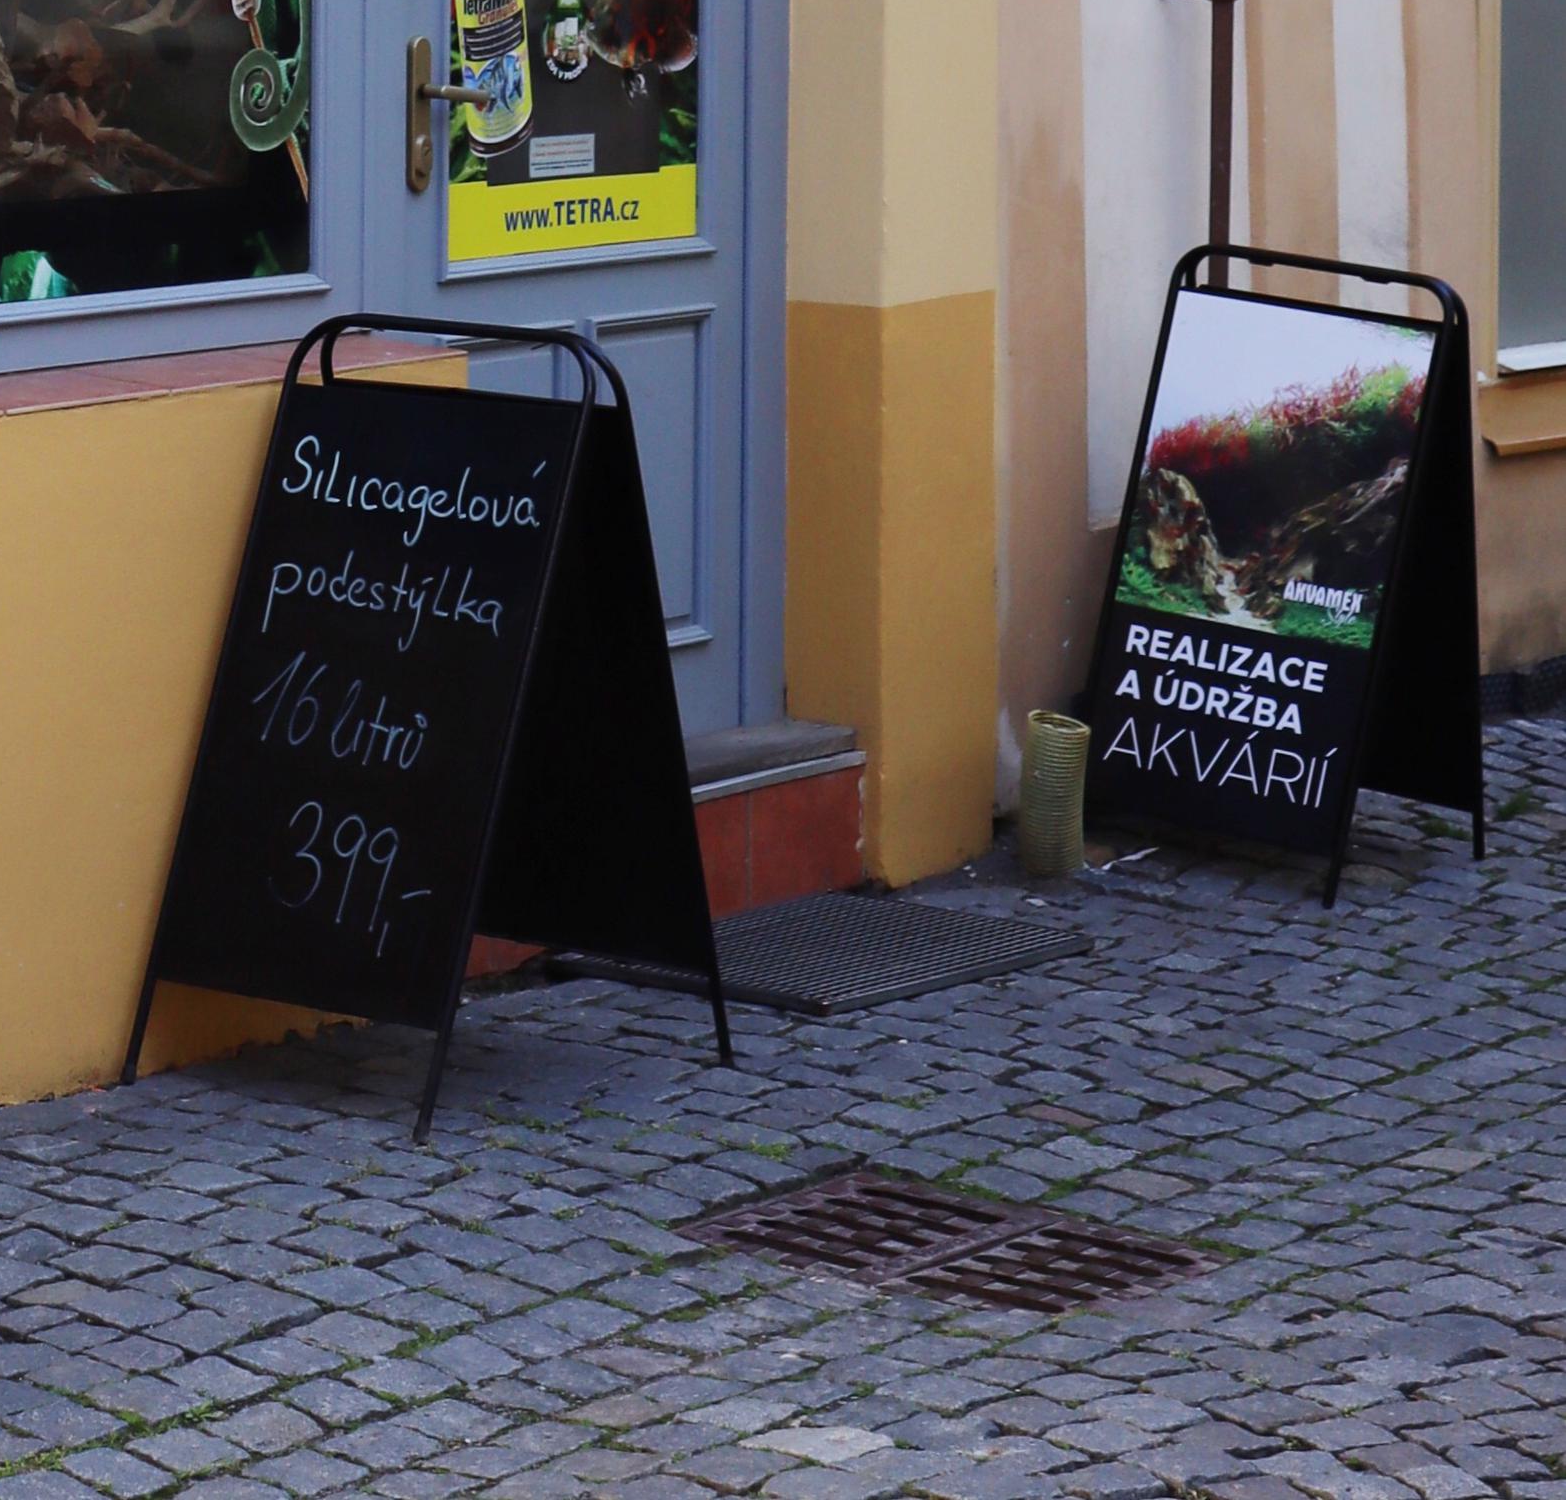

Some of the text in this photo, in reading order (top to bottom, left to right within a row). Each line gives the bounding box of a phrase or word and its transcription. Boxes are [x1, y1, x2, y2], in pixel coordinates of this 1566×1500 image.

[1284, 579, 1363, 614] AKVAMEX
[1125, 624, 1328, 693] REALIZACE
[252, 651, 327, 745] 16
[1115, 669, 1302, 735] A ÚDRŽBA
[1102, 716, 1338, 808] AKVÁRIÍ
